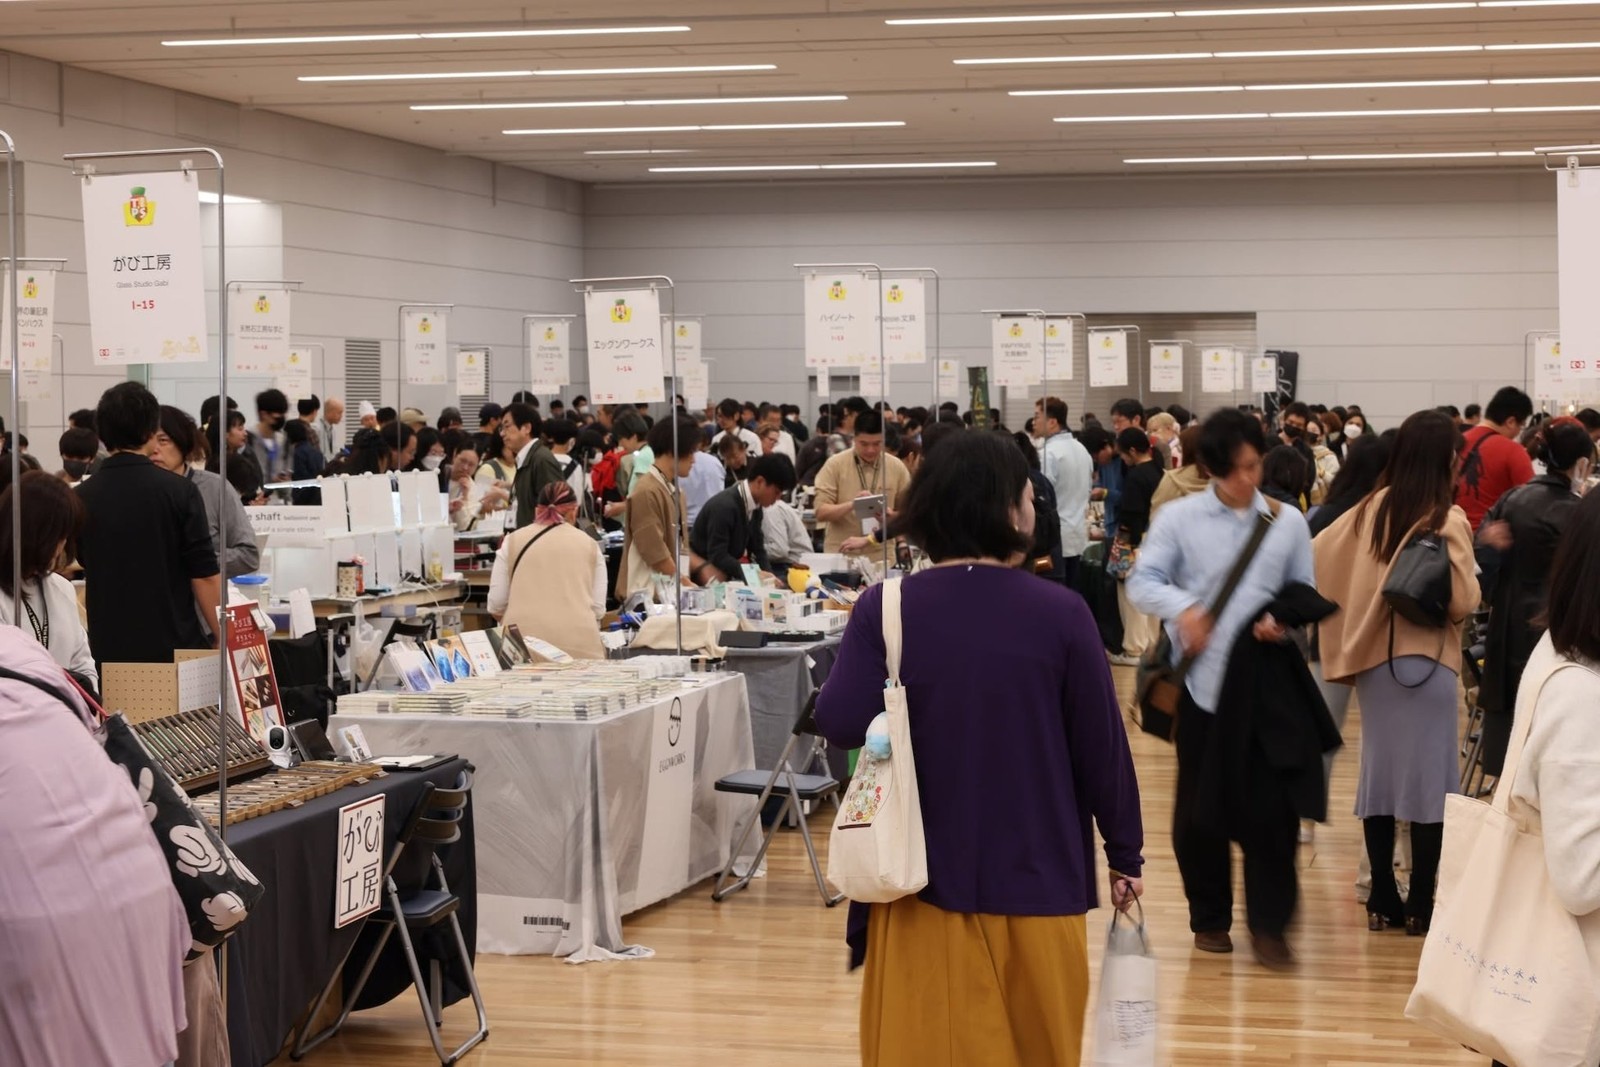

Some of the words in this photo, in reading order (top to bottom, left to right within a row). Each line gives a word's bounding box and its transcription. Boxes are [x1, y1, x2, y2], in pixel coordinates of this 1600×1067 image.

[113, 254, 171, 272] がび工房
[134, 280, 153, 288] Studio
[154, 279, 169, 287] Gabi
[16, 306, 48, 317] 界の筆記具
[16, 319, 44, 328] ンハウス
[594, 337, 656, 350] エッグンワークス
[255, 512, 281, 521] shaft
